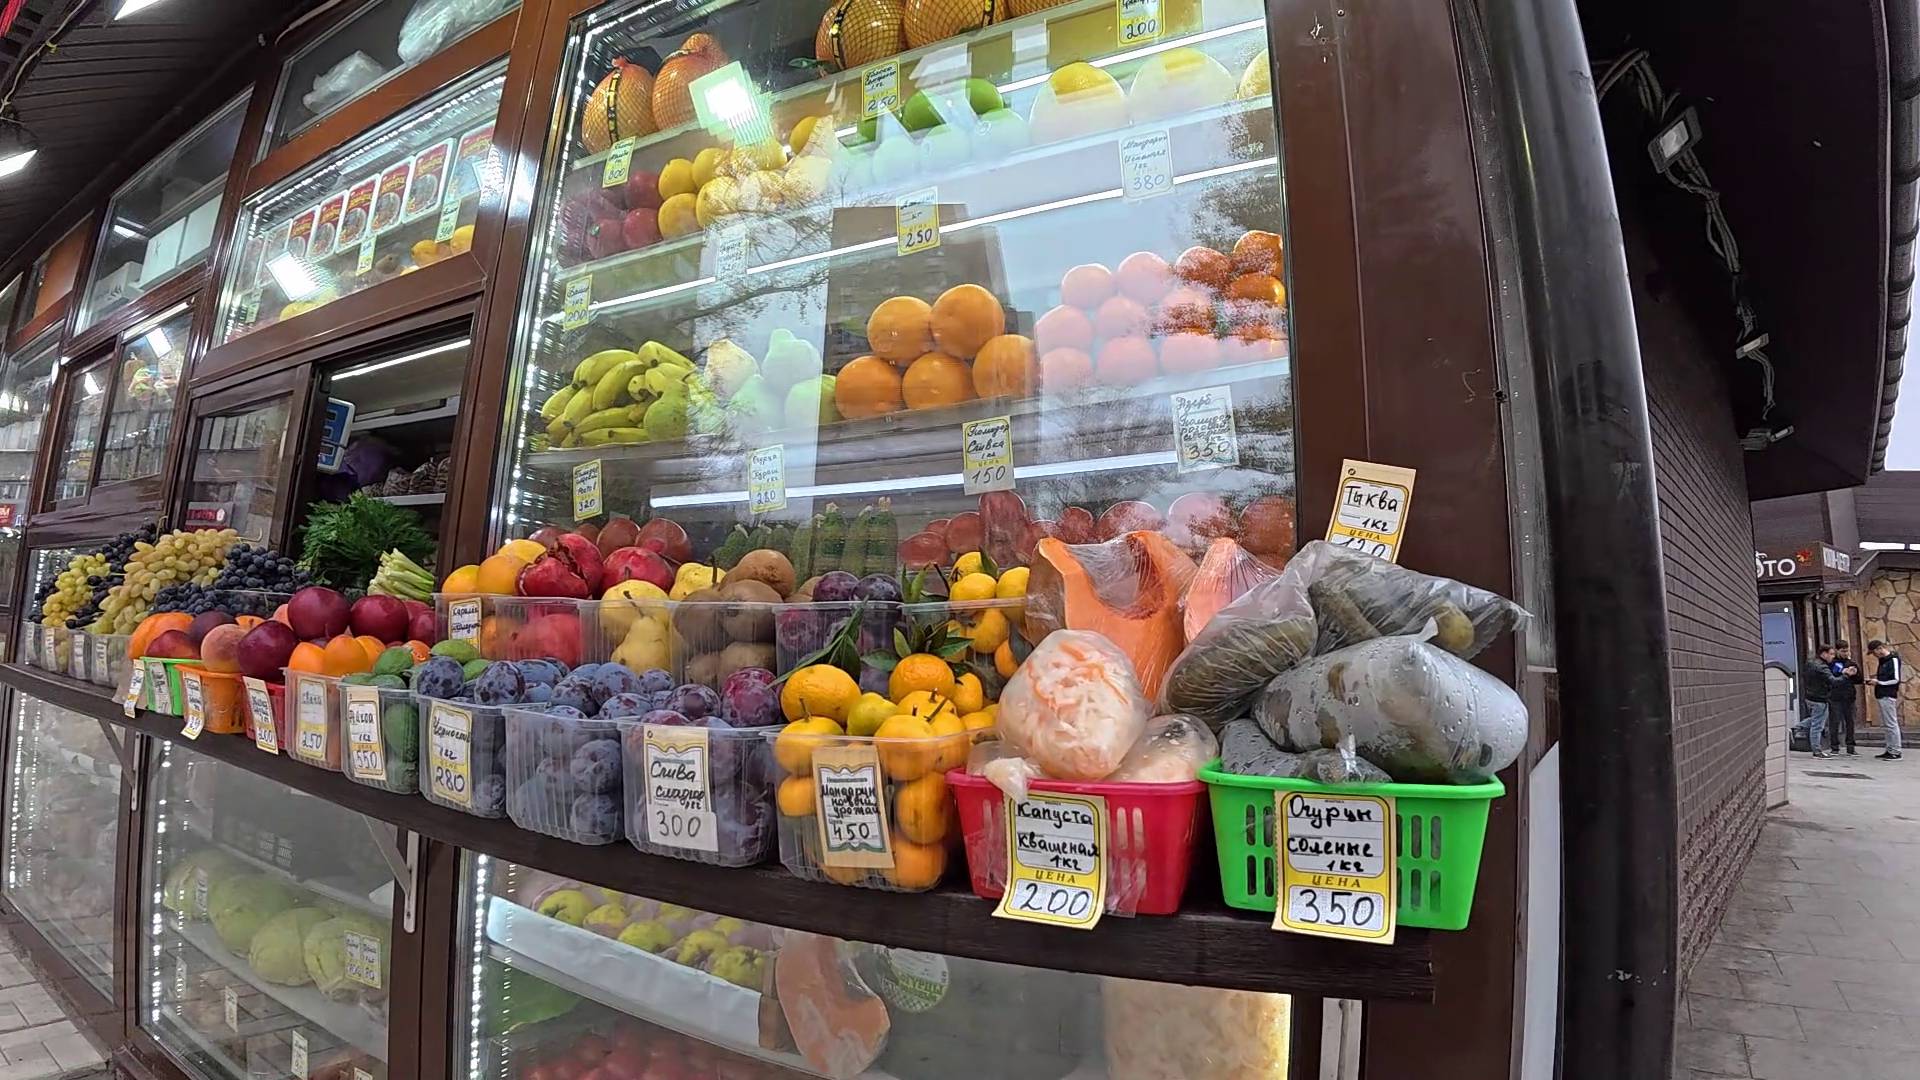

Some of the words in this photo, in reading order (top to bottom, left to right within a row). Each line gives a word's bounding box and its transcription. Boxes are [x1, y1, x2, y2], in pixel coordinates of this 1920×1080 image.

[1126, 19, 1156, 39] 200
[1133, 174, 1165, 190] 380
[906, 228, 933, 248] 250
[1189, 441, 1230, 460] 350
[971, 465, 1006, 484] 150
[1344, 485, 1399, 513] Тыква
[1349, 529, 1380, 540] ЦЕНА
[1361, 518, 1389, 532] 1кг
[435, 765, 466, 793] 280
[650, 760, 697, 783] Слива
[656, 810, 702, 838] 300
[1017, 801, 1094, 829] Капуста
[832, 822, 870, 840] 450
[1050, 854, 1082, 871] 1кг
[1326, 859, 1365, 873] 1кг
[1035, 870, 1077, 884] ЦЕНА
[1310, 875, 1362, 889] ЦЕНА
[1020, 882, 1090, 916] 200
[1299, 889, 1375, 926] 350
